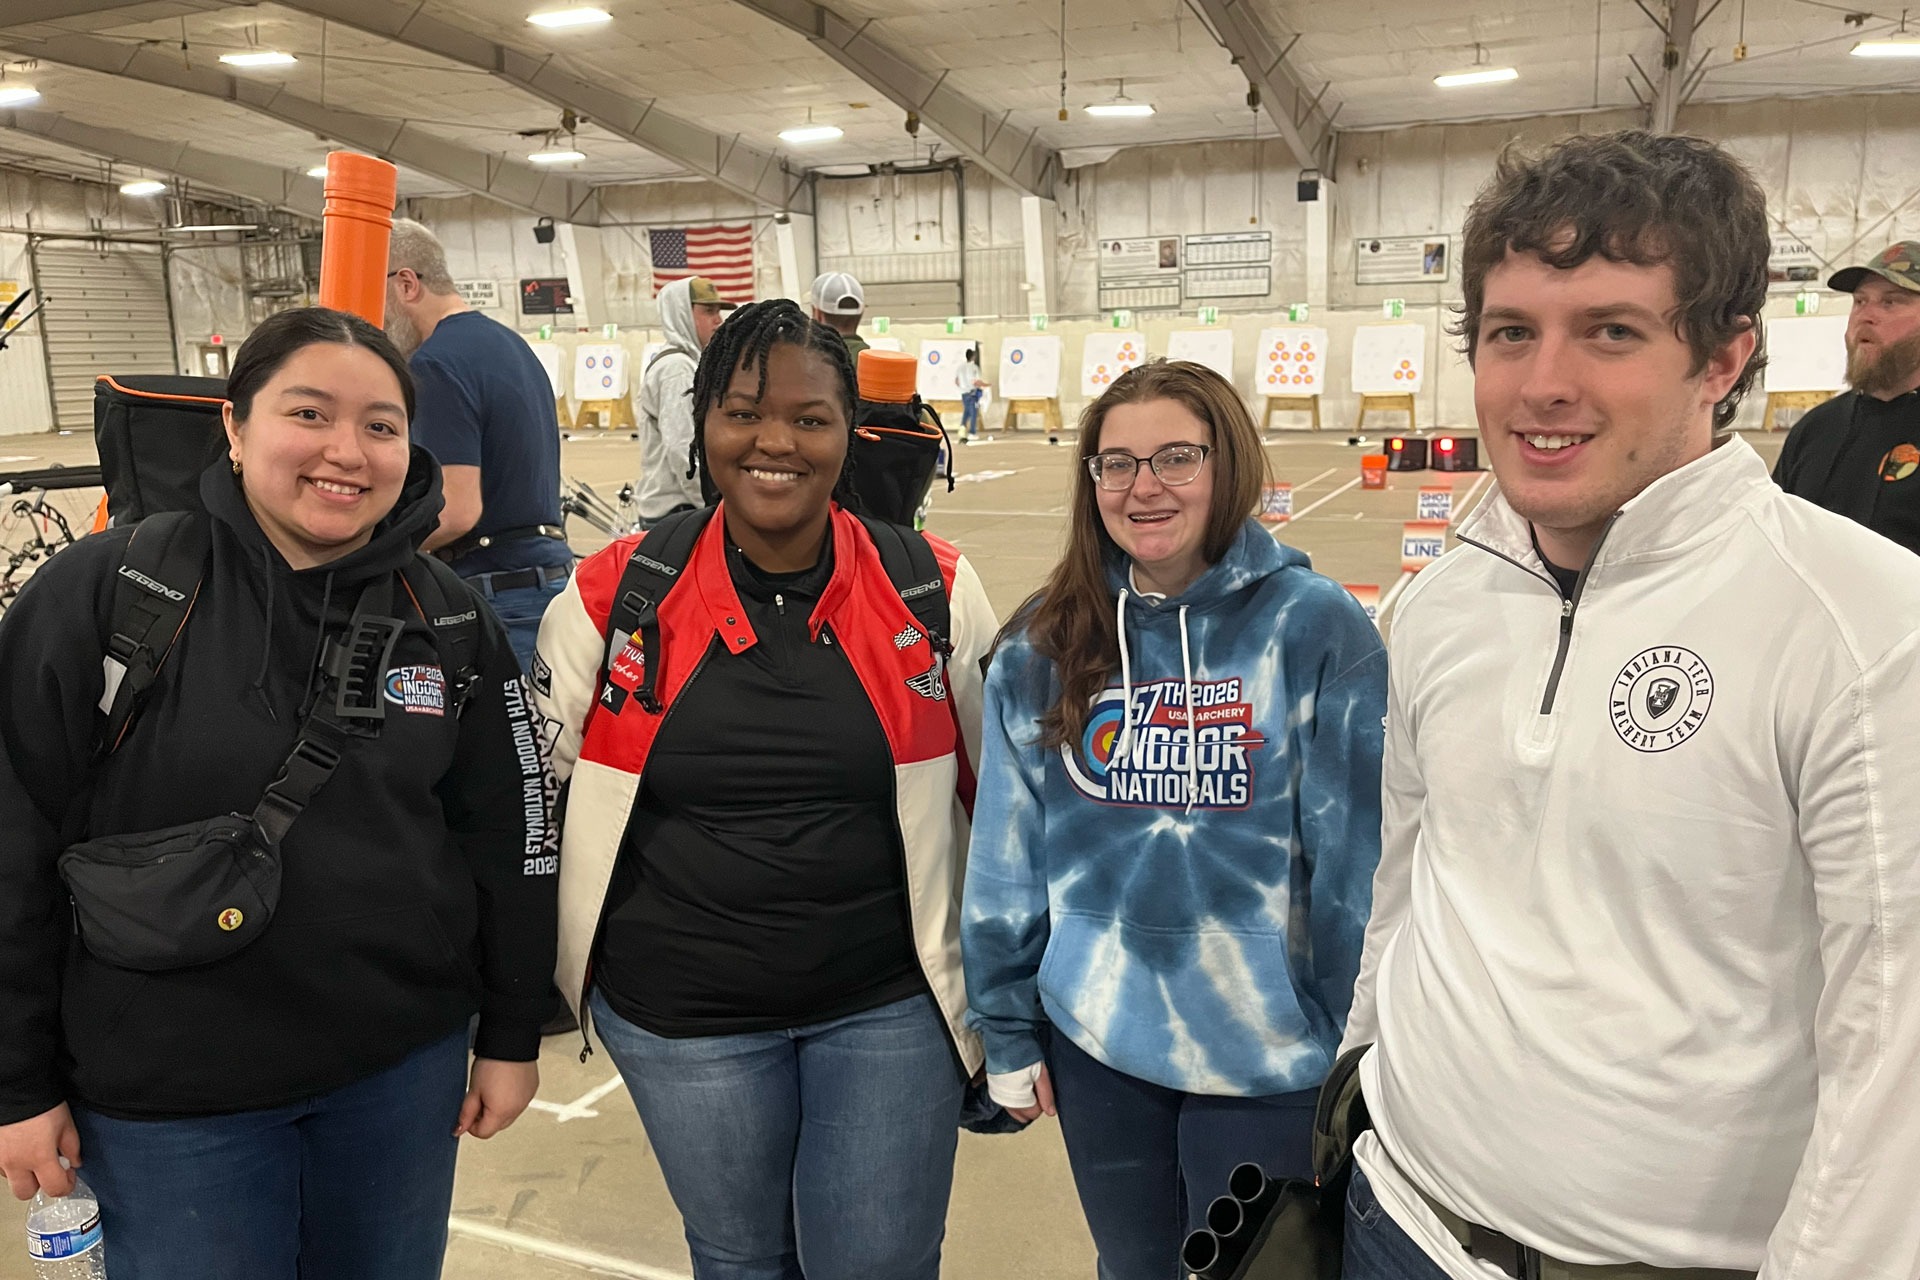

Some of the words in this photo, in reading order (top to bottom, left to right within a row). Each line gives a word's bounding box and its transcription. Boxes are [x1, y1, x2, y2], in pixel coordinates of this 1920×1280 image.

[1420, 509, 1449, 519] LINE
[1404, 543, 1442, 557] LINE
[630, 553, 678, 576] LEGEND
[118, 565, 186, 601] LEGEND
[900, 579, 941, 597] EGEND
[433, 610, 477, 626] LEGEND
[1617, 650, 1682, 687] INDIANA
[1687, 660, 1710, 697] TECH
[404, 694, 444, 709] NATIONALS
[503, 678, 527, 718] 57TH
[1190, 679, 1240, 707] 2026
[1195, 707, 1246, 722] ARCHERY
[1613, 700, 1656, 748] ARCHERY
[1666, 709, 1703, 743] TEAM
[511, 719, 541, 775] INDOOR
[1111, 770, 1248, 806] NATIONALS
[523, 777, 545, 855] NATIONALS
